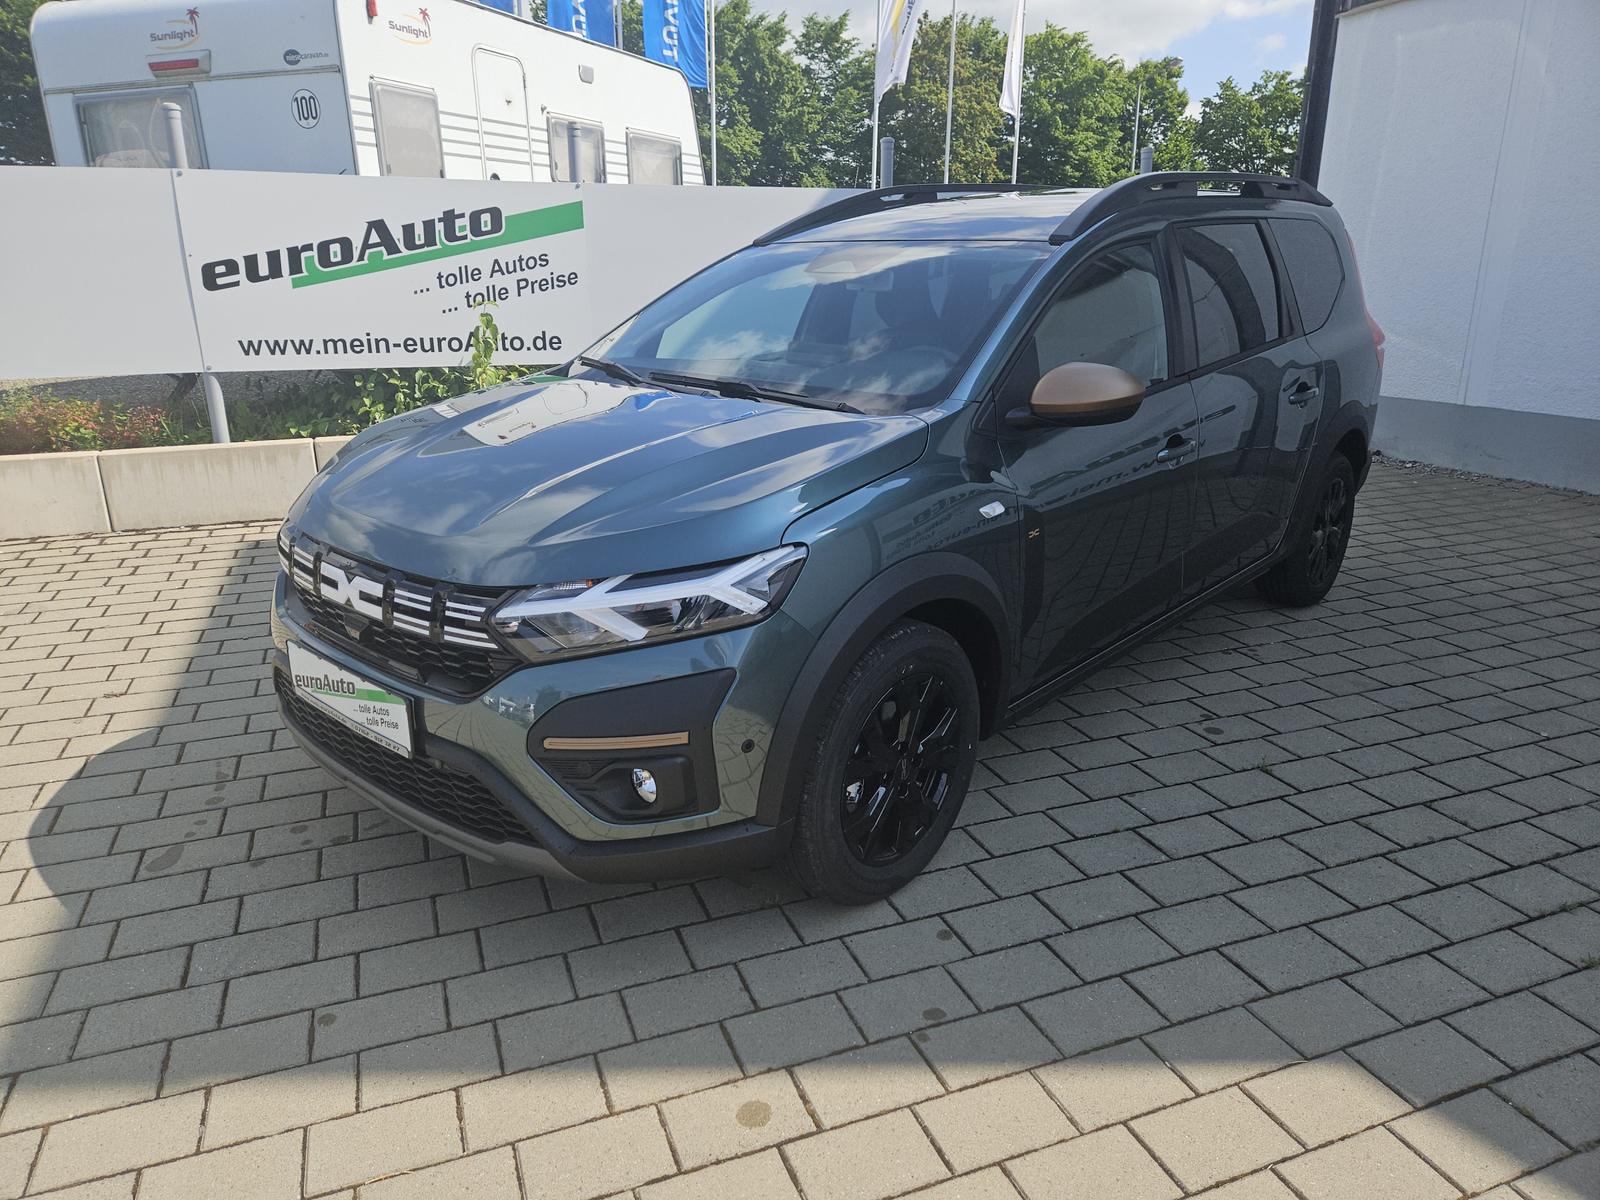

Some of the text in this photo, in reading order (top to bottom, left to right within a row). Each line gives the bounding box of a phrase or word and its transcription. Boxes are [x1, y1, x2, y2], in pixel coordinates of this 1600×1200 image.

[150, 29, 195, 42] Sunlight
[388, 20, 429, 39] Sunlight
[293, 95, 318, 121] 100
[200, 206, 504, 292] euroAuto
[437, 265, 482, 289] tolle
[490, 253, 550, 279] Autos
[465, 285, 509, 308] tolle
[516, 271, 579, 297] Preise
[238, 331, 562, 355] www.mein-euroAto.de
[294, 674, 356, 695] euroAuto
[359, 704, 371, 715] tolle
[372, 706, 390, 716] Autos
[366, 717, 379, 727] tolle
[380, 718, 399, 730] Preise
